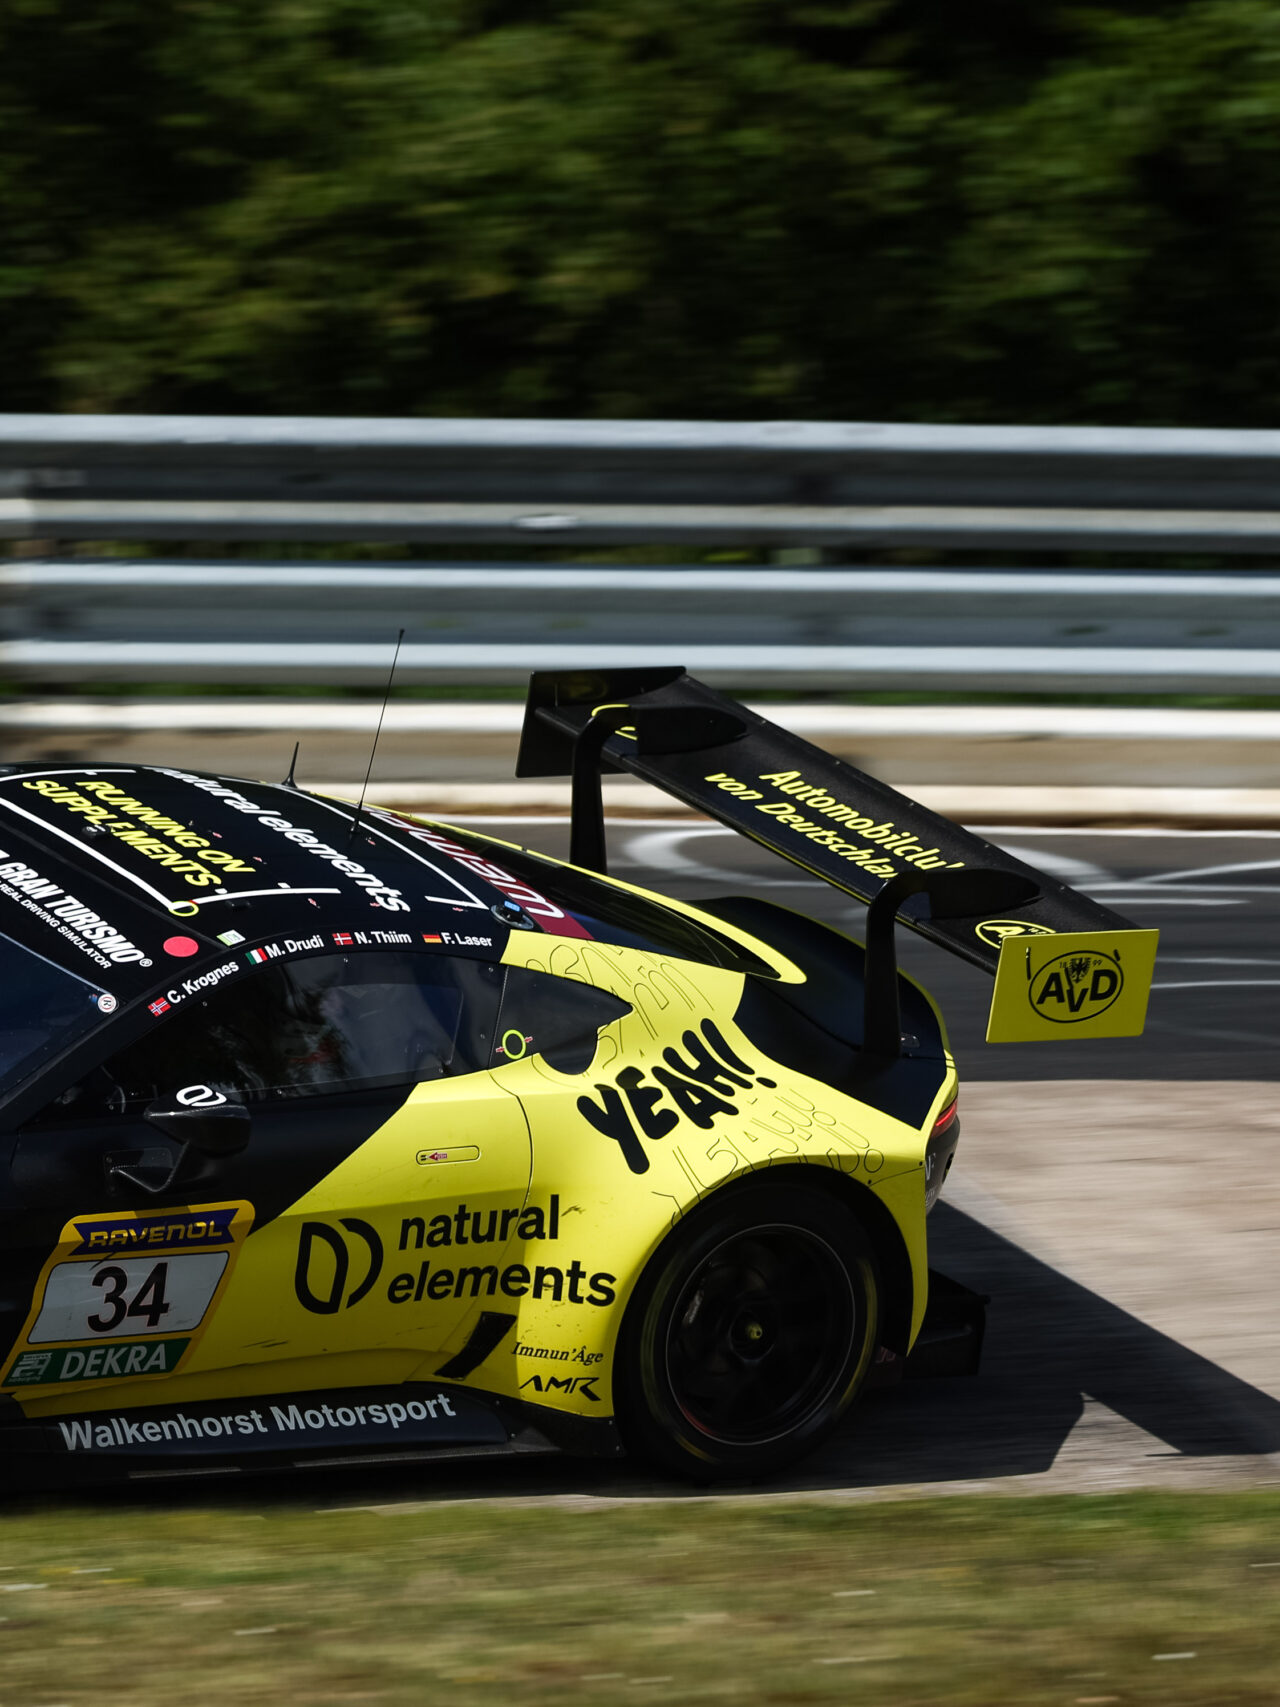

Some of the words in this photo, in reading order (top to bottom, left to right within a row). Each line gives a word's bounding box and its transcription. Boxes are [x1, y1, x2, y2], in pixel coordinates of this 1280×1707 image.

[704, 773, 763, 800] von
[22, 780, 222, 887] SUPPLEMENTS
[75, 781, 210, 848] RUNNING
[197, 850, 256, 872] ON
[759, 771, 965, 870] Automobilclu
[258, 816, 411, 912] elements
[21, 899, 60, 928] DRIVING
[57, 926, 112, 969] SIMULATOR
[264, 943, 286, 959] M.
[285, 934, 325, 954] Drudi
[354, 931, 371, 945] N.
[371, 930, 412, 944] Thiim
[441, 932, 455, 945] F.
[454, 932, 493, 947] Laser
[167, 989, 187, 1004] C.
[182, 961, 240, 996] Krognes
[577, 1017, 778, 1175] YEAH!
[88, 1219, 223, 1248] RAVENOL
[399, 1194, 560, 1250] natural
[87, 1262, 170, 1332] 34
[387, 1260, 617, 1307] elements
[59, 1343, 168, 1380] DEKRA
[519, 1374, 602, 1402] AMR
[59, 1408, 269, 1451] Walkenhorst
[270, 1393, 457, 1431] Motorsport
